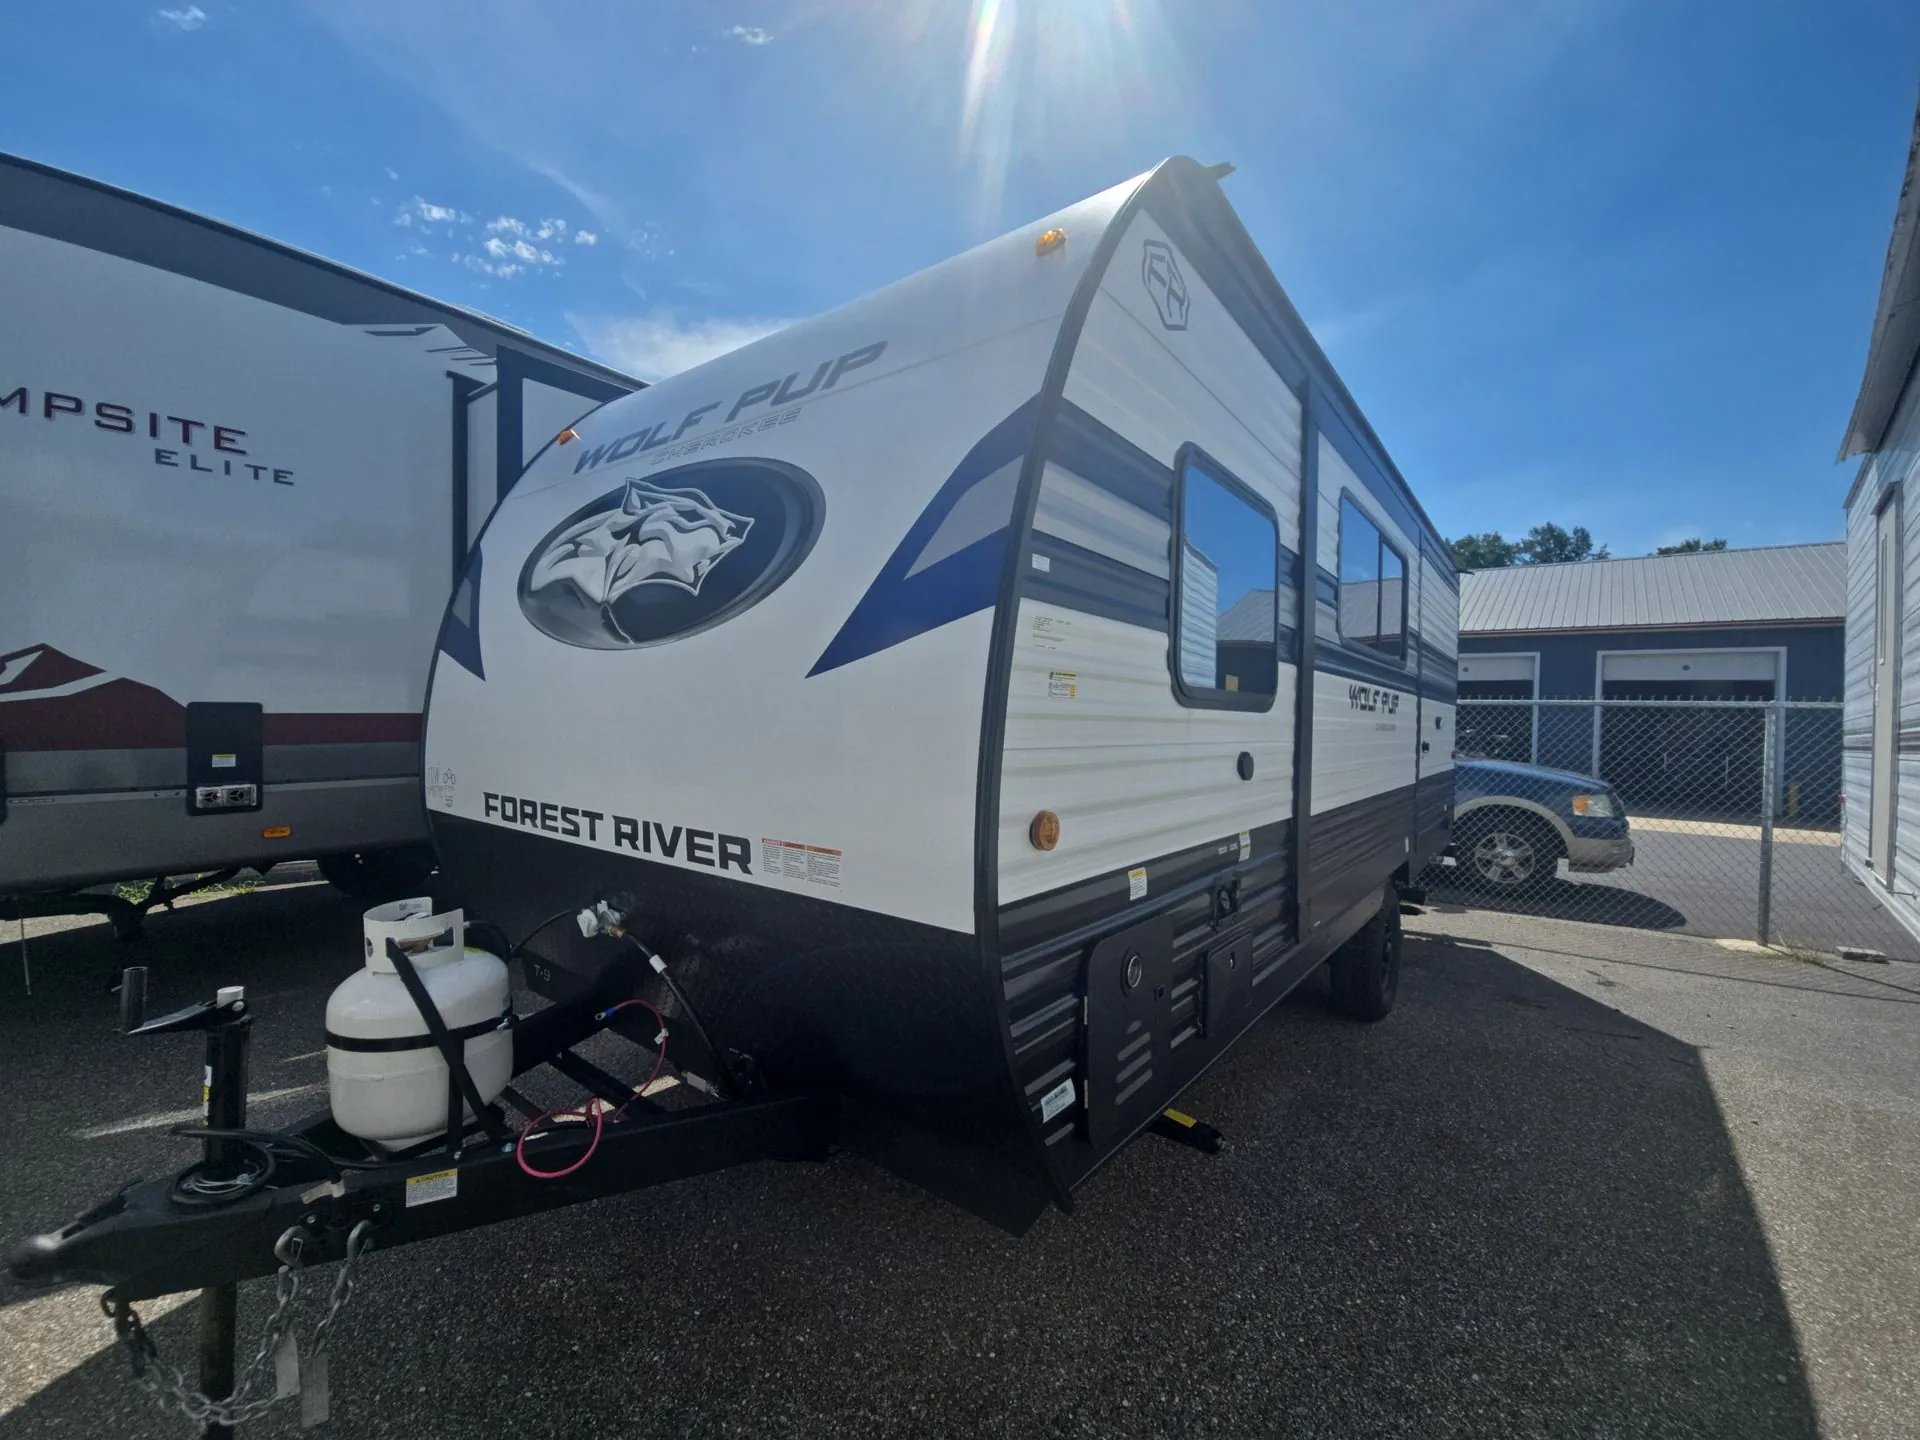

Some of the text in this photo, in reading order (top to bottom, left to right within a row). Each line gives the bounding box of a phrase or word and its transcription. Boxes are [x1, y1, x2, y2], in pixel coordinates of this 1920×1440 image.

[573, 340, 888, 475] WOLF PUP
[651, 407, 802, 466] CHEROKEE
[154, 448, 294, 486] ELITE
[1349, 684, 1399, 715] WOLF PUP
[483, 792, 604, 841] FOREST
[612, 814, 753, 876] RIVER
